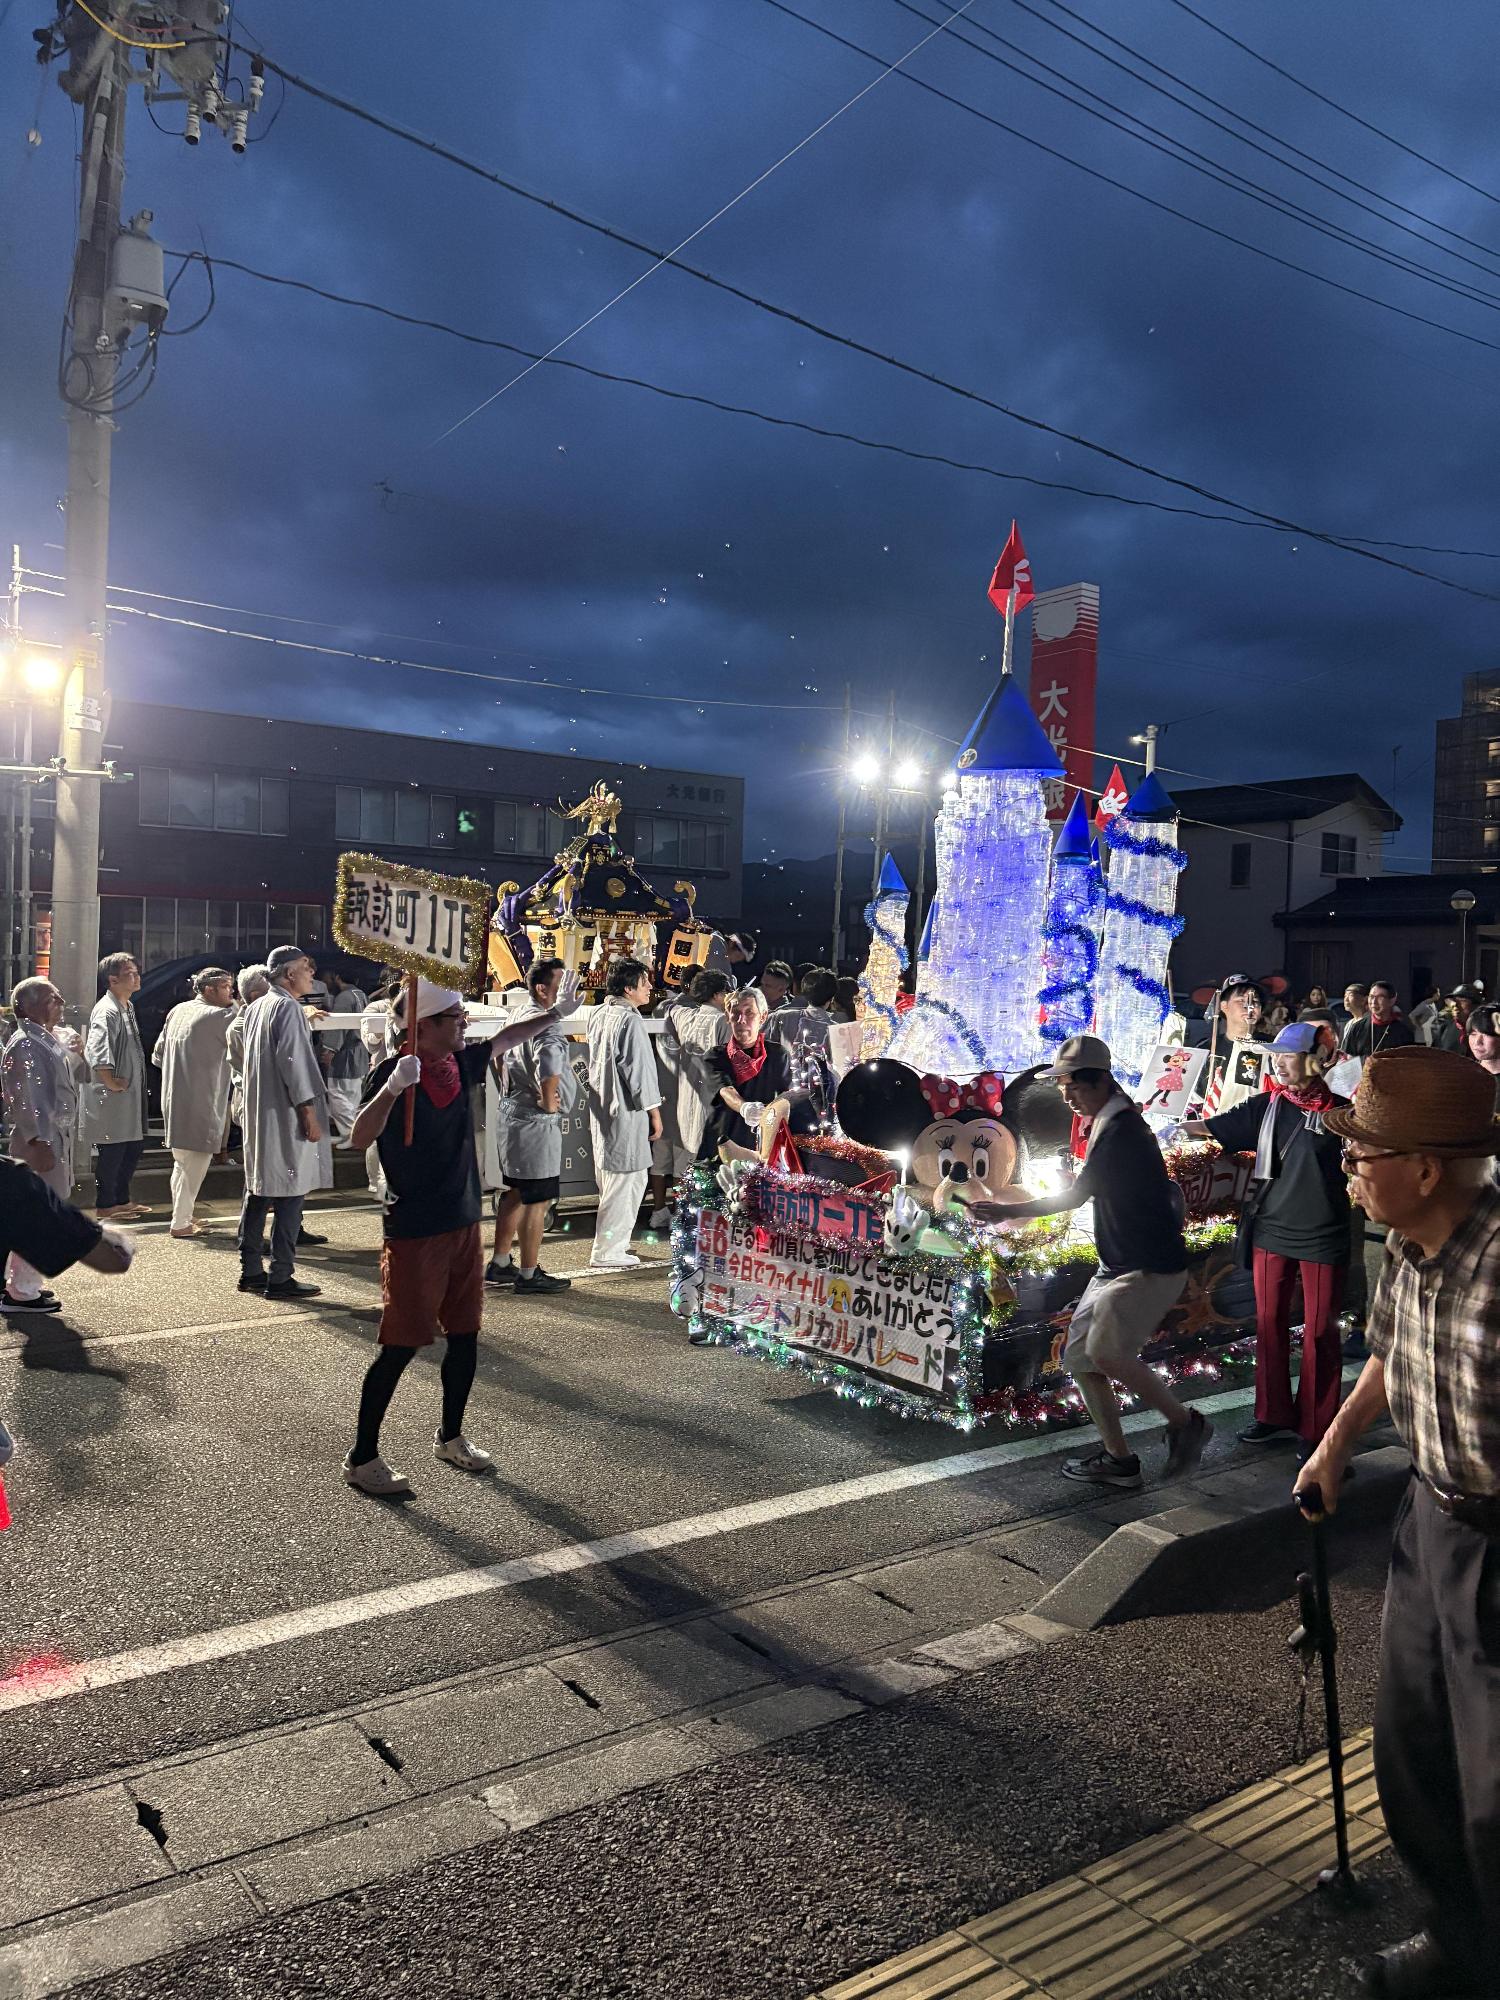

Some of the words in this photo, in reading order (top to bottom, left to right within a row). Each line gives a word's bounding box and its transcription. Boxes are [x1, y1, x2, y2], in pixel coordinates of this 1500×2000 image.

[698, 1209, 729, 1257] 56
[728, 1252, 827, 1306] 今日でファイナル
[852, 1286, 957, 1345] ありがとう
